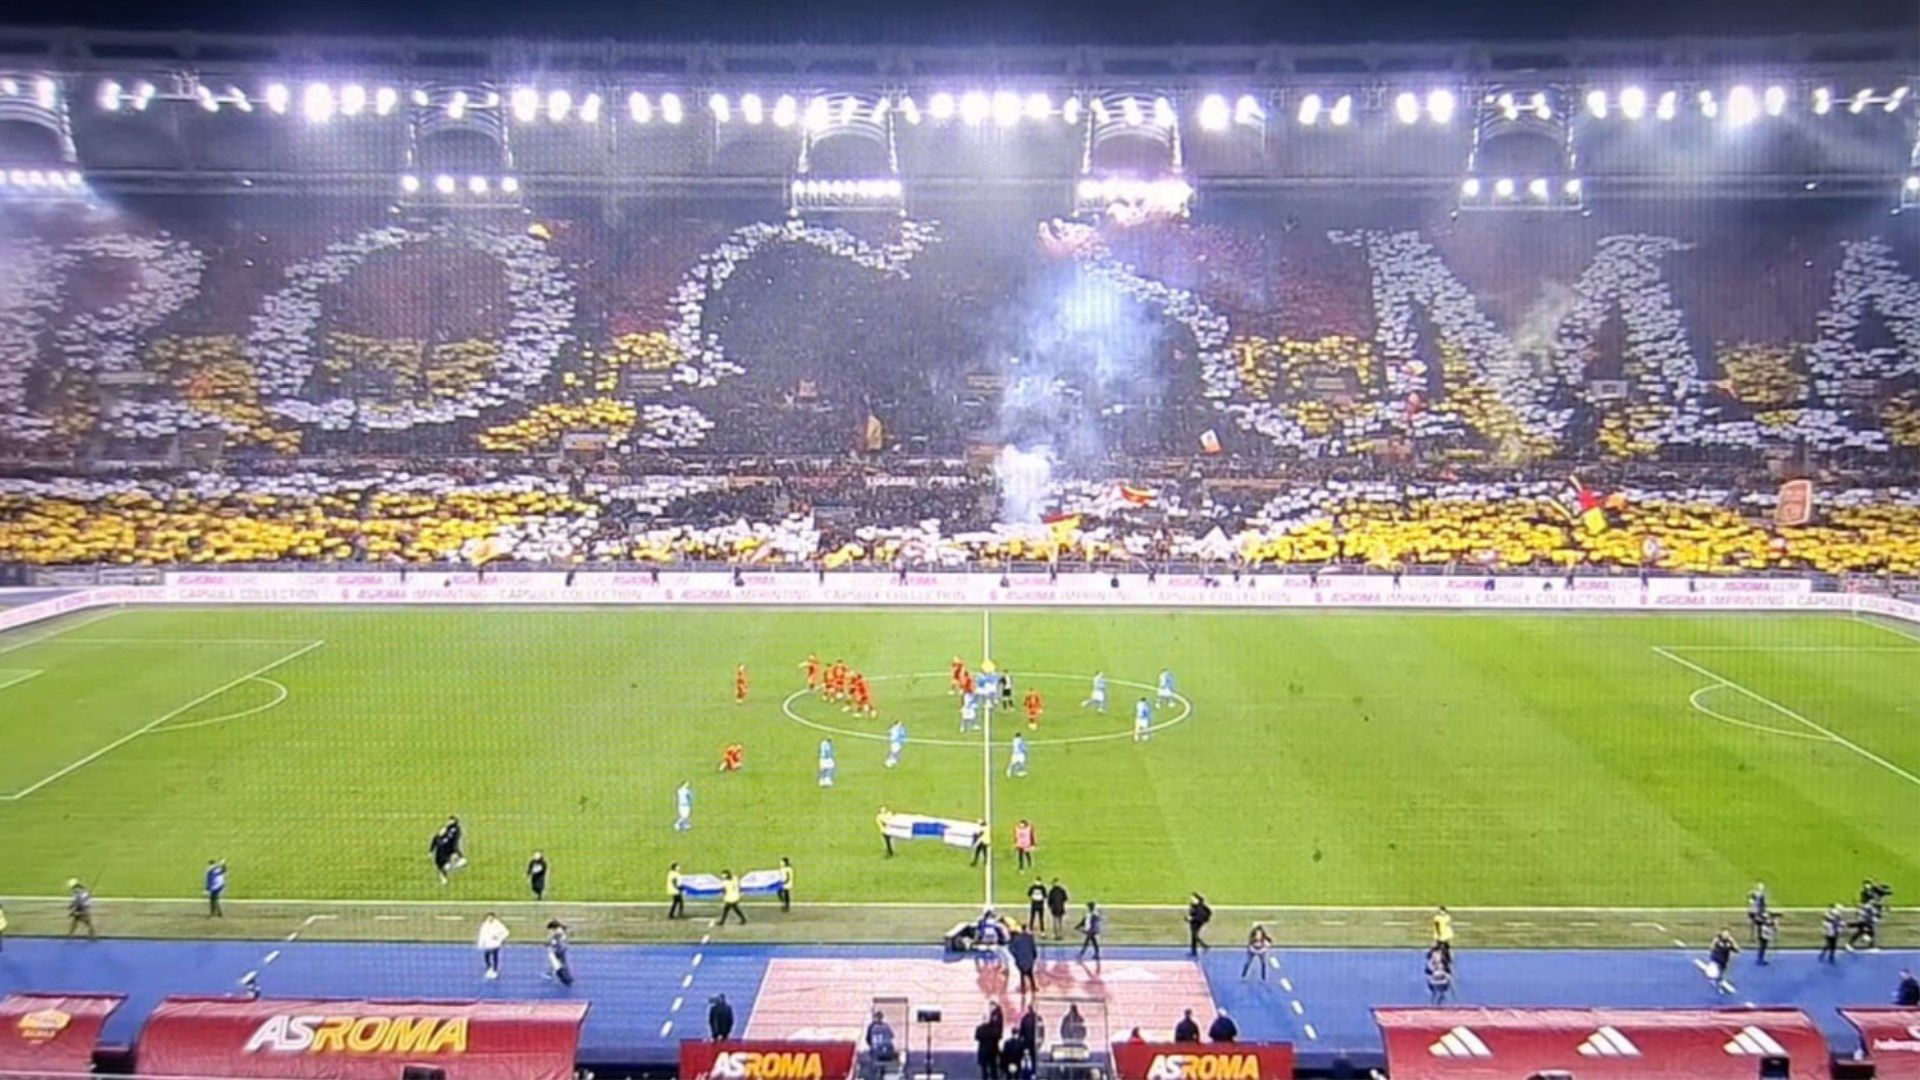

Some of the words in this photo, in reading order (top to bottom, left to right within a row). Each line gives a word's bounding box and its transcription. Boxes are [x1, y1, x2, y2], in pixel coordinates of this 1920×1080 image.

[1655, 594, 1706, 605] ASROMA
[245, 1015, 468, 1051] ASROMA
[711, 1052, 823, 1078] ASROMA
